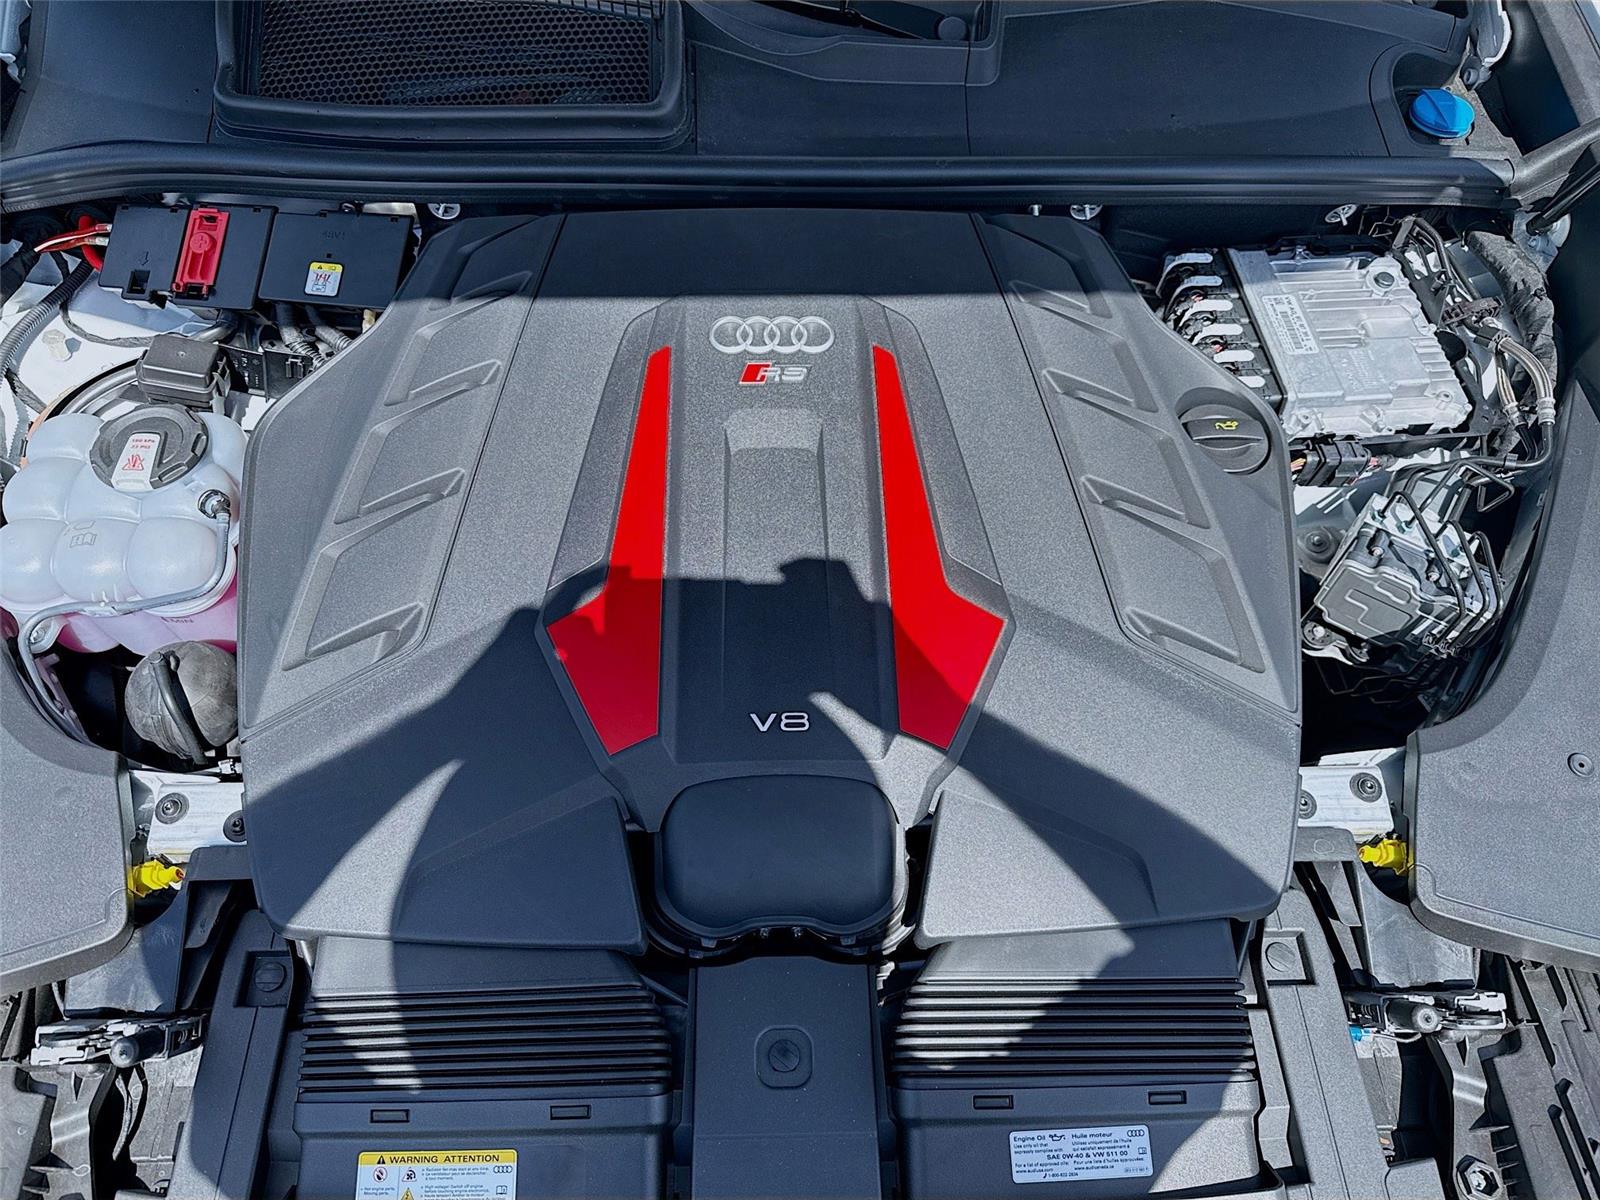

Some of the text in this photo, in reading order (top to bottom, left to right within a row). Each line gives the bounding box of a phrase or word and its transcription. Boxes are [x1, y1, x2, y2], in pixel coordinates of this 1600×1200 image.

[744, 363, 809, 384] RS
[750, 712, 810, 731] V8
[389, 1154, 500, 1164] WARNING ATTENTION
